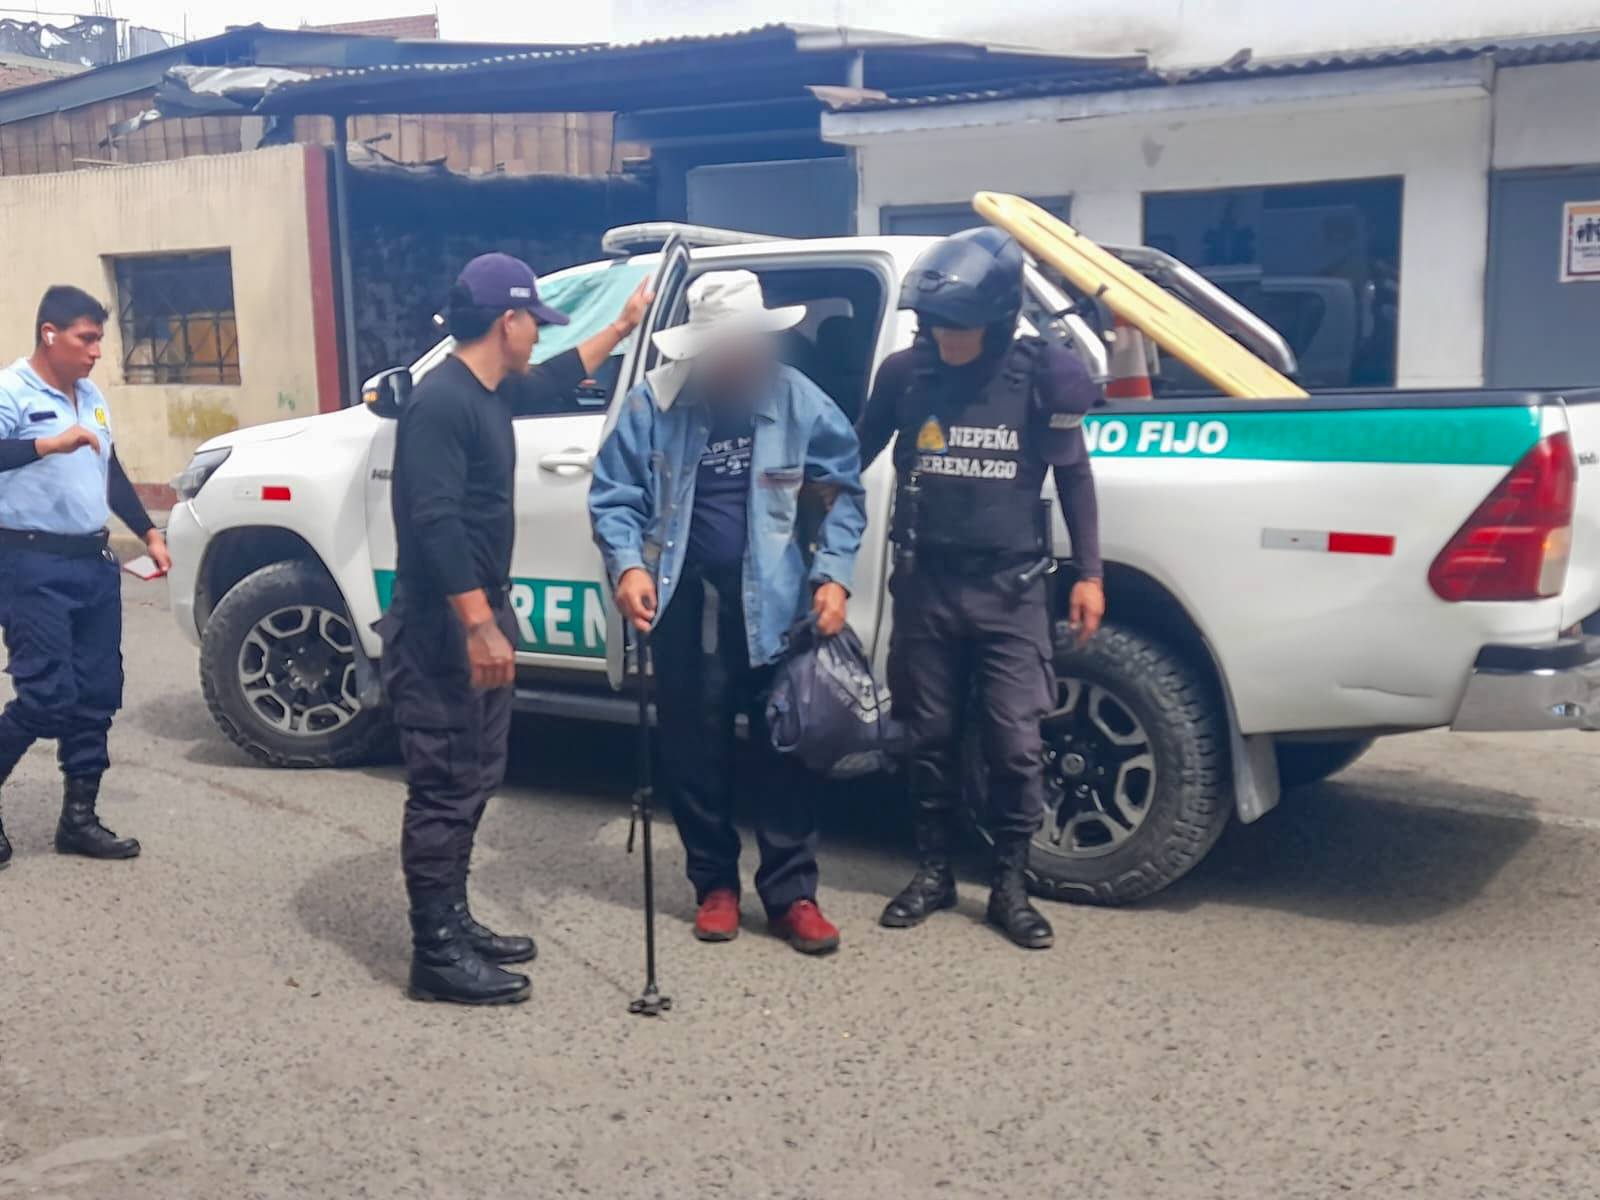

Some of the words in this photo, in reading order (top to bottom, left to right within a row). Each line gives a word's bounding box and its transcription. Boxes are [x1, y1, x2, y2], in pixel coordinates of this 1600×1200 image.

[948, 424, 1020, 451] NEPEÑA
[1136, 420, 1229, 454] FIJO
[915, 455, 1018, 479] ERENAZGO
